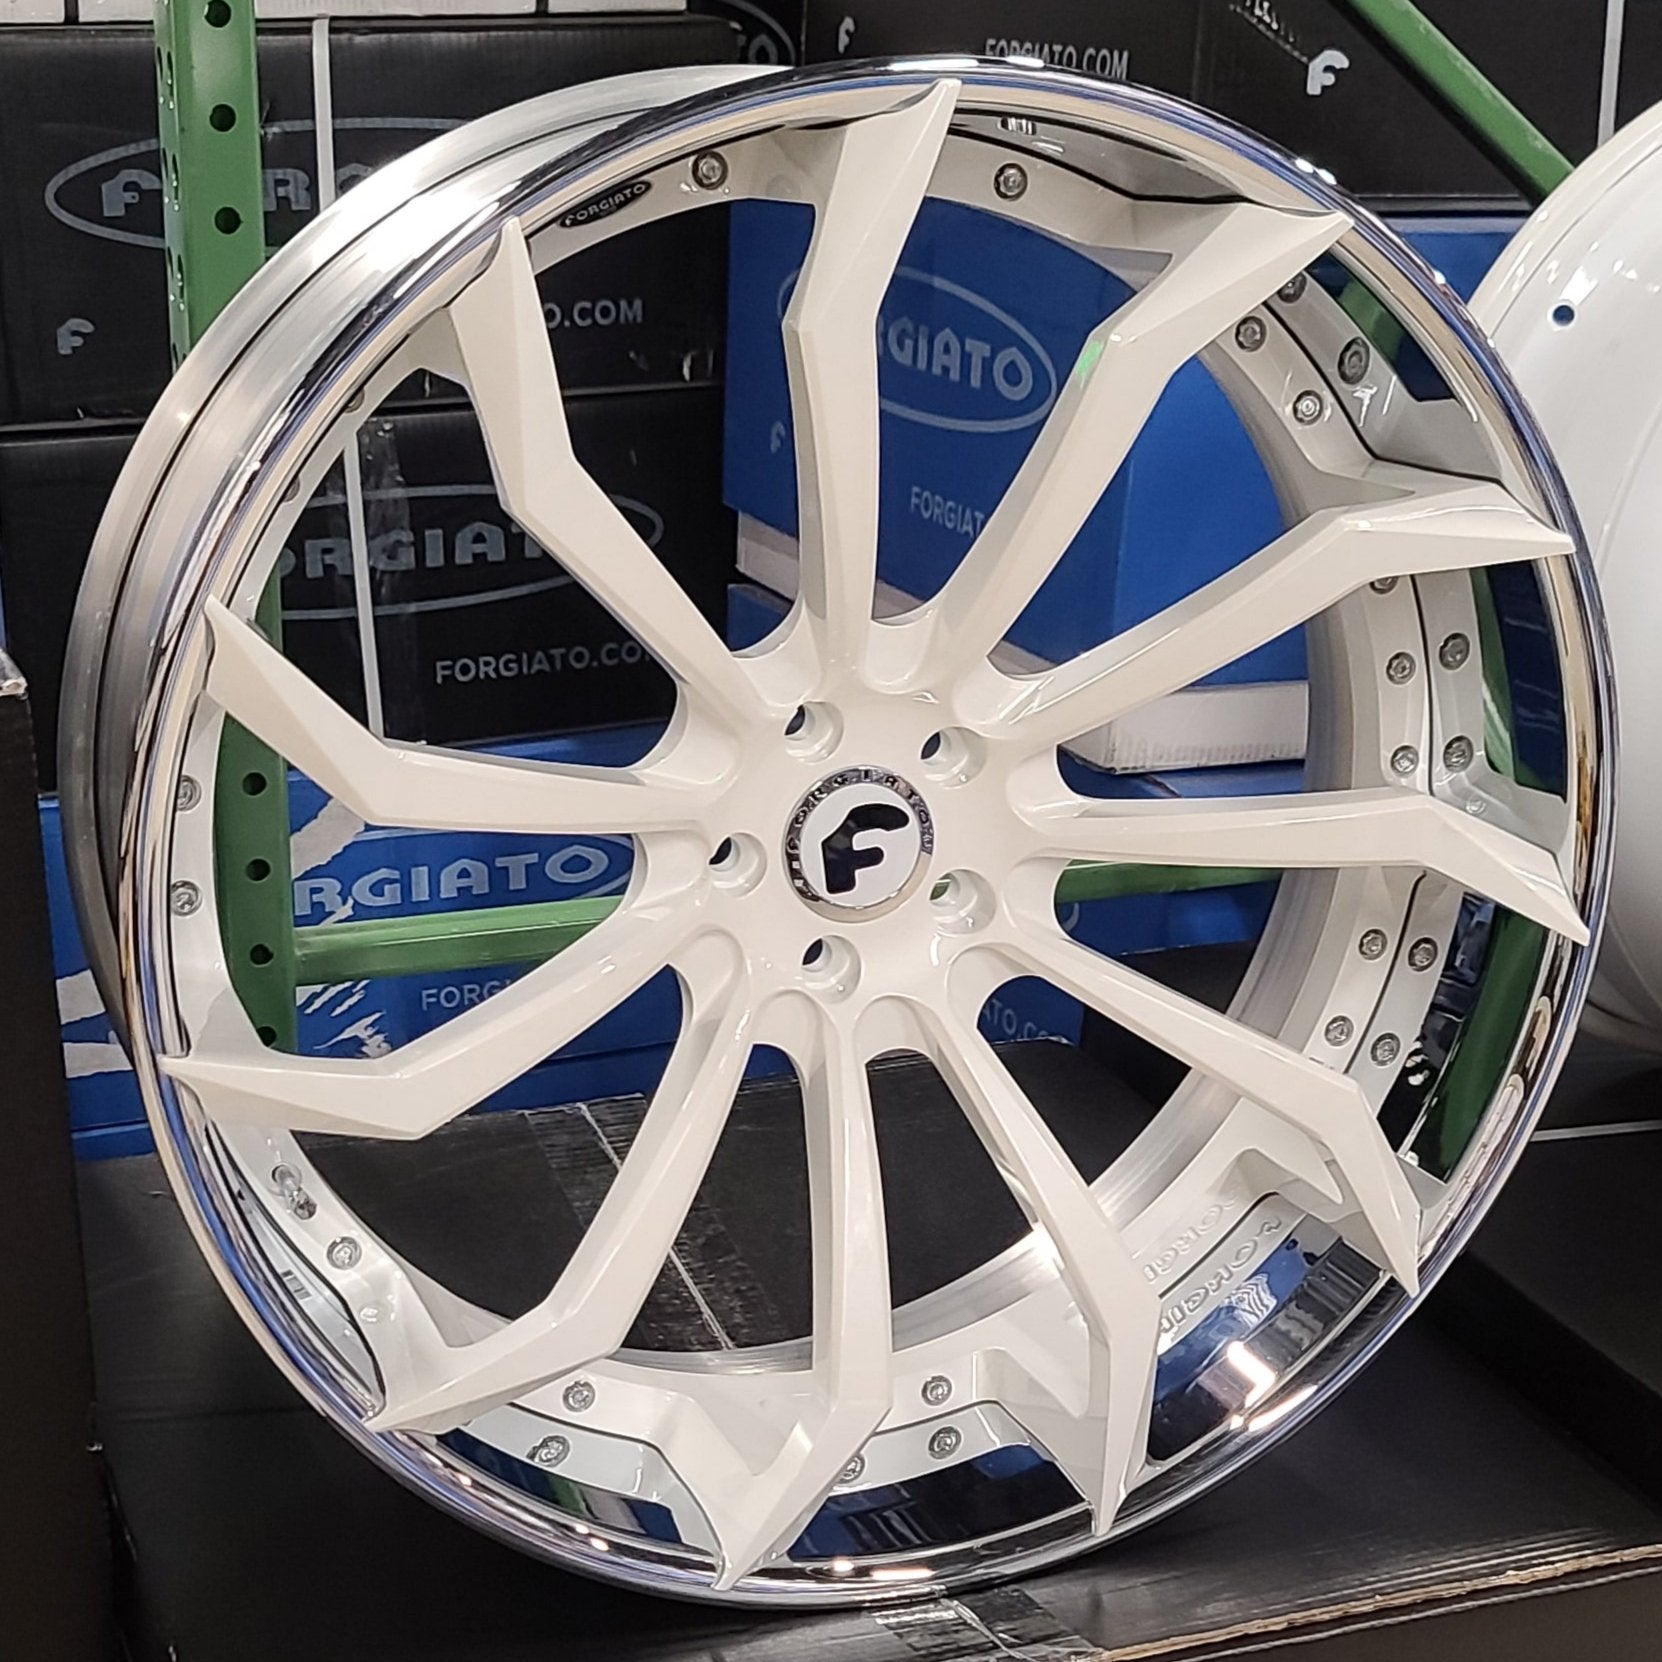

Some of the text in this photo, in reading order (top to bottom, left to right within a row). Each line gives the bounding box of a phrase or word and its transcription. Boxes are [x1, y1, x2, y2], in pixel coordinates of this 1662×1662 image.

[1307, 50, 1349, 95] F
[565, 183, 646, 226] FORGIATO
[57, 317, 96, 356] F
[880, 315, 1033, 401] GIATO
[436, 640, 650, 685] FORGIATO.CO
[821, 803, 909, 895] F
[293, 844, 609, 916] RGIATO
